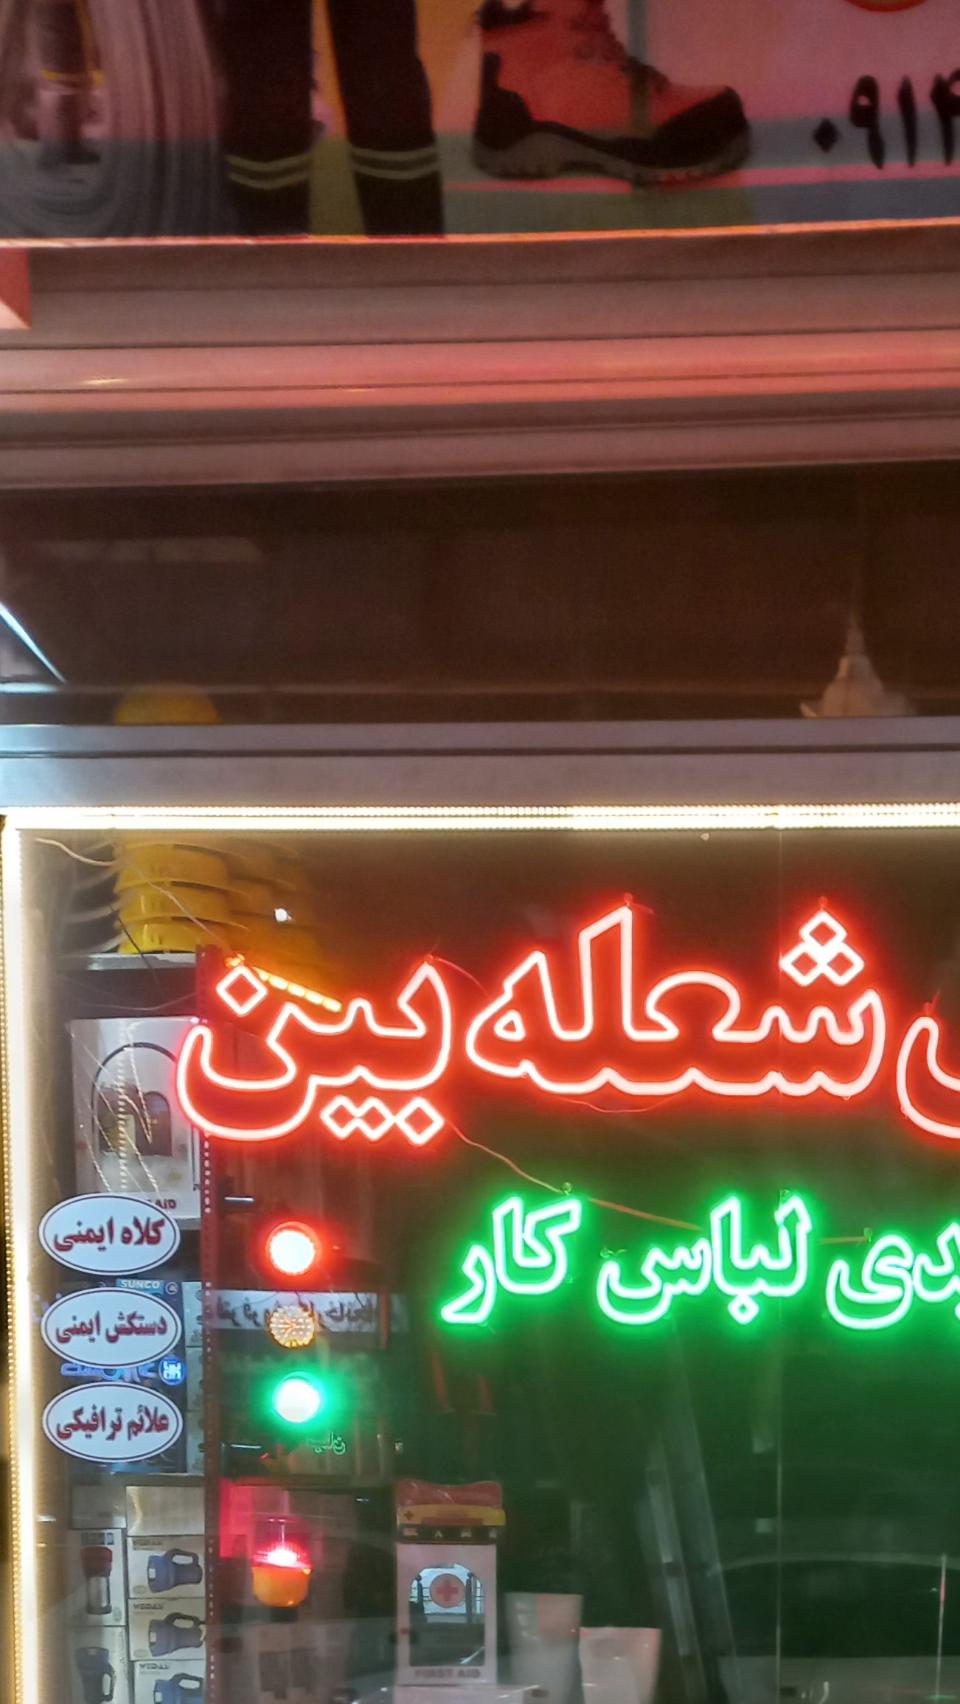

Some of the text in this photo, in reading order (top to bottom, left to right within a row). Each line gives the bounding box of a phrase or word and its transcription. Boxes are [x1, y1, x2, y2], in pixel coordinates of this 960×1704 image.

[177, 964, 452, 1146] بین
[466, 905, 887, 1097] شعله
[54, 1216, 166, 1252] کلاه ایمنی
[440, 1196, 582, 1324] کار
[597, 1196, 813, 1325] لباس
[56, 1311, 167, 1344] دستکش ایمنی
[57, 1403, 169, 1441] علائم ترافیکی
